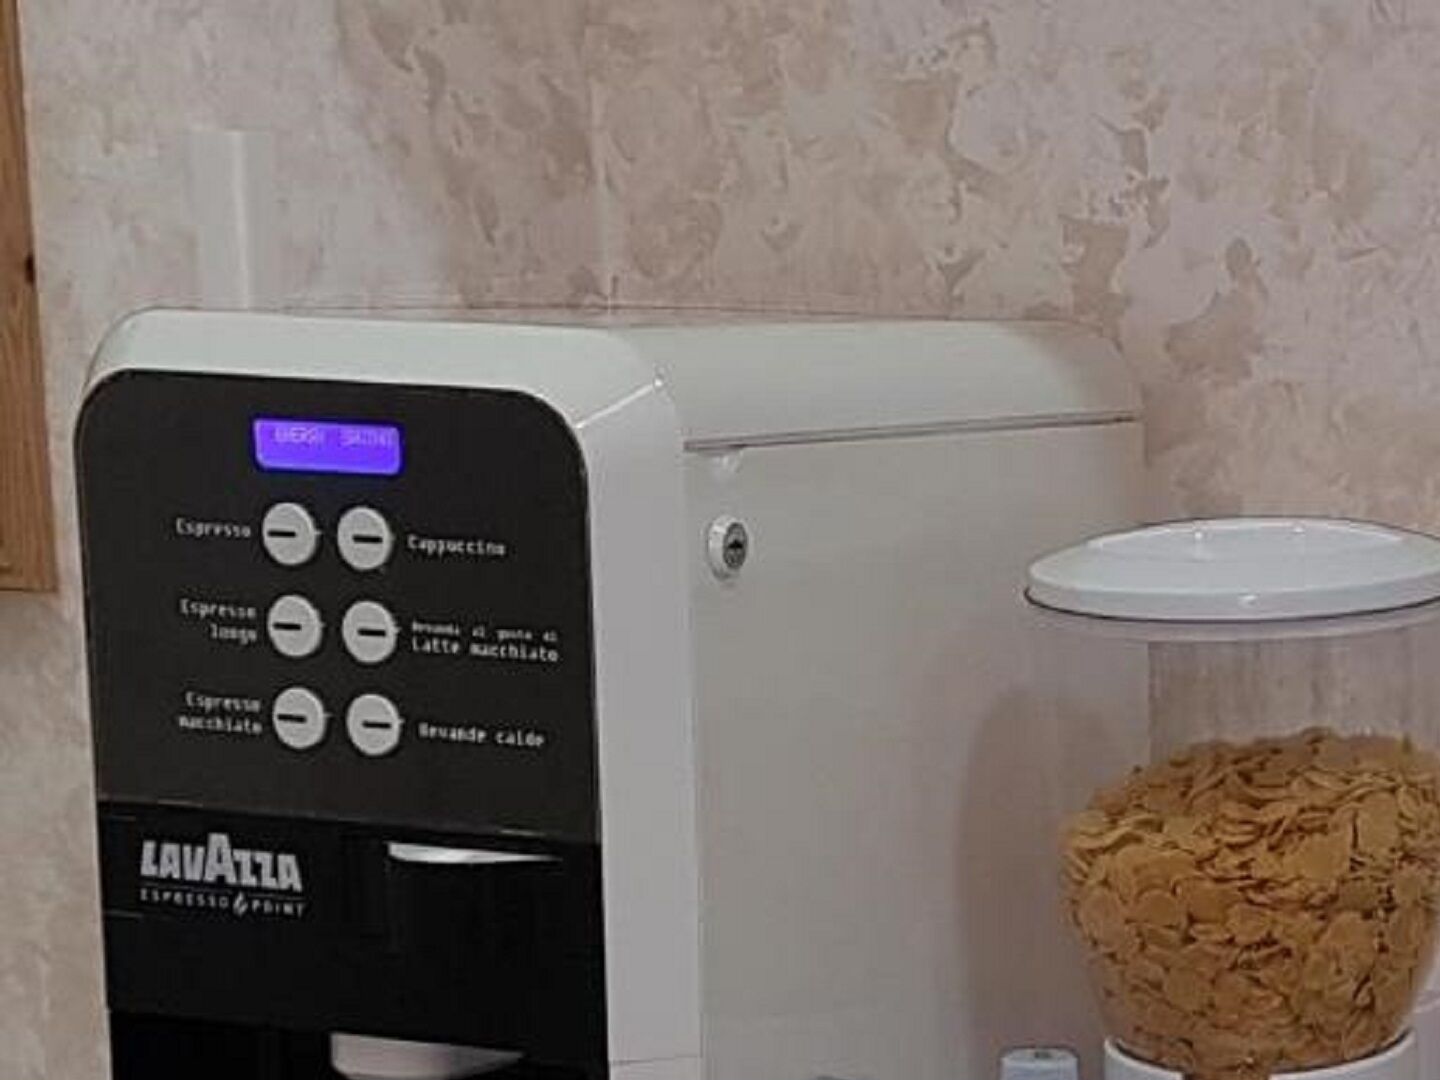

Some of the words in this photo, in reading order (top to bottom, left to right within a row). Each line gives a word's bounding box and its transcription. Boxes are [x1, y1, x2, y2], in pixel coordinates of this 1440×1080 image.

[175, 517, 252, 539] Espresso
[407, 534, 506, 558] Cappuccino
[179, 598, 257, 619] Espresso
[184, 691, 262, 713] Espresso
[140, 832, 303, 893] LAVAZZA
[140, 887, 230, 909] ESPRESSO
[251, 897, 307, 919] POINT
